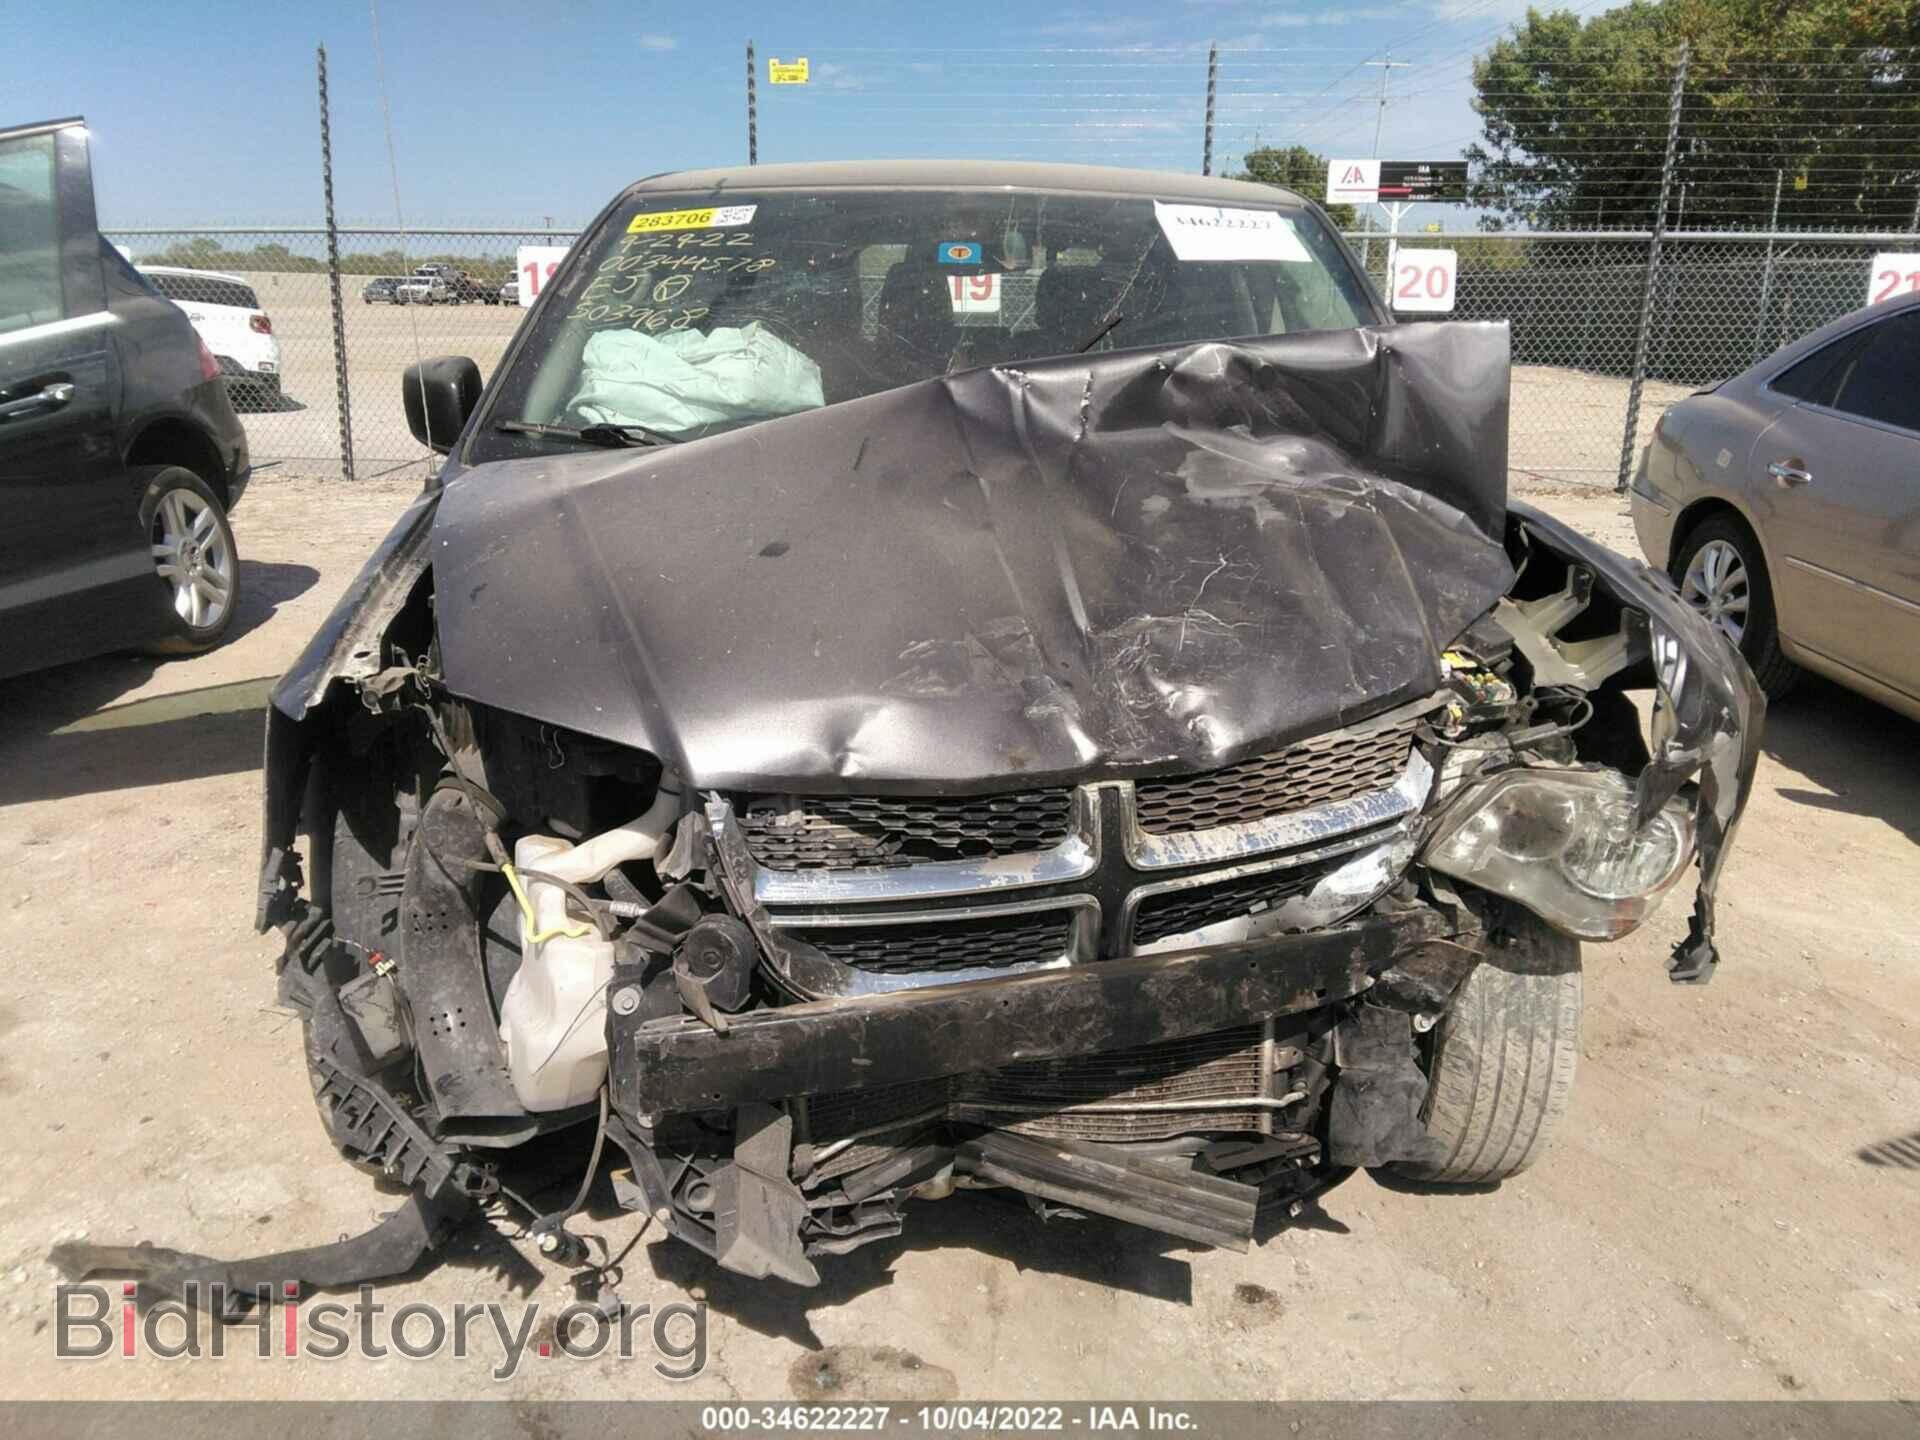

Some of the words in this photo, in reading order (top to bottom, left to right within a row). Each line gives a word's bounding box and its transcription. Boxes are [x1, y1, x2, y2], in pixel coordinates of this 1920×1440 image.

[635, 212, 712, 228] 283706
[954, 273, 993, 301] 19
[1399, 265, 1449, 299] 20
